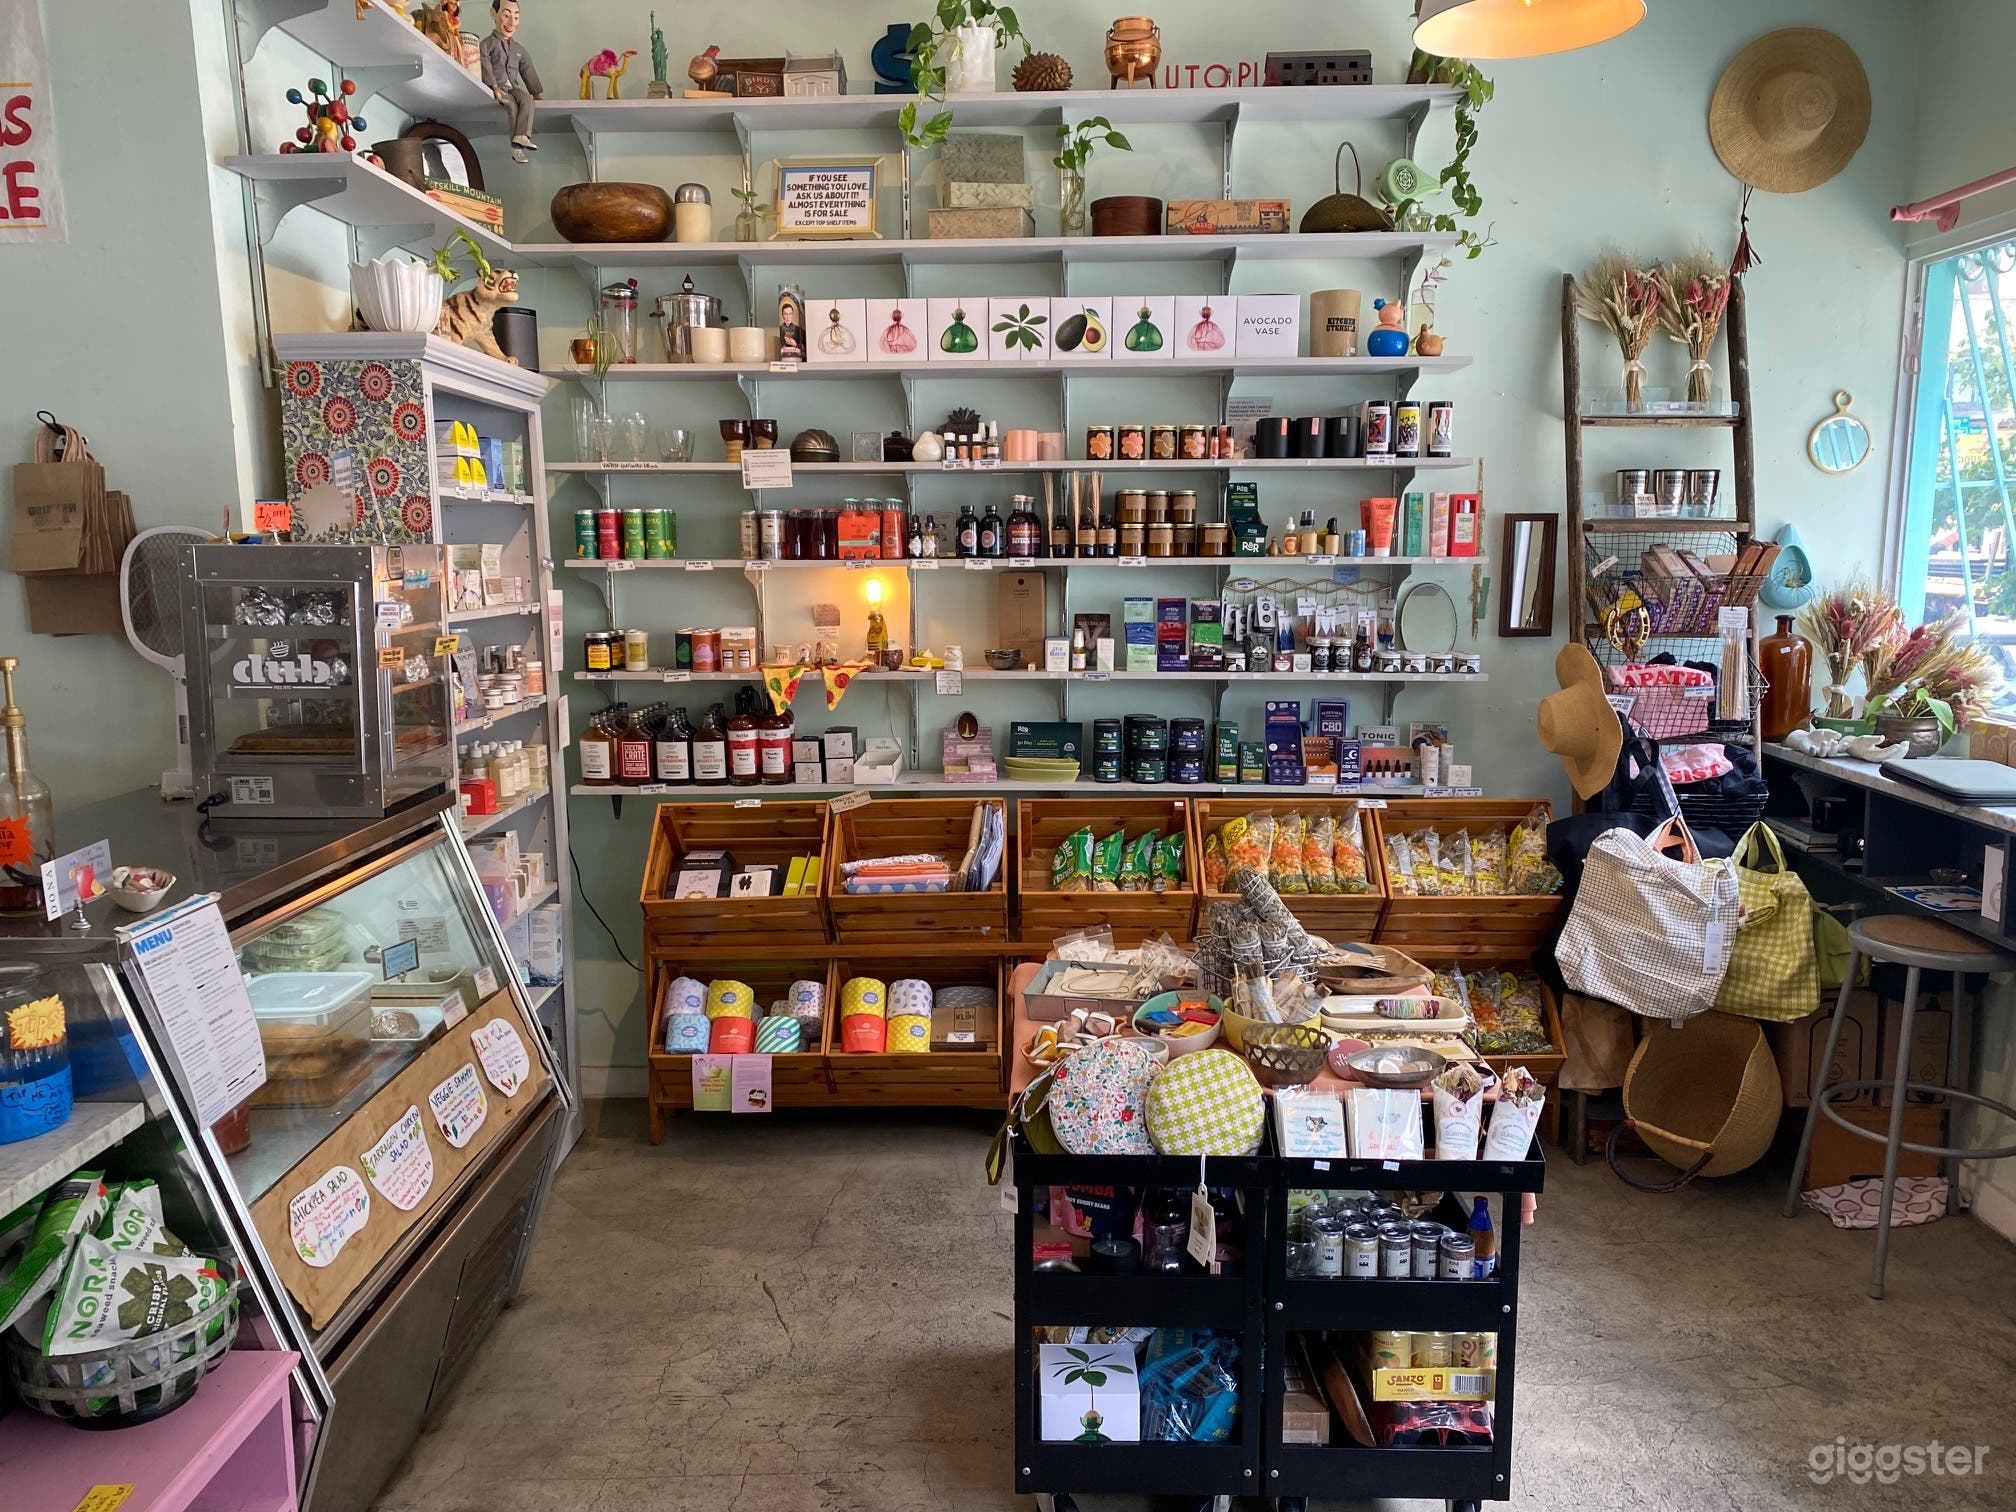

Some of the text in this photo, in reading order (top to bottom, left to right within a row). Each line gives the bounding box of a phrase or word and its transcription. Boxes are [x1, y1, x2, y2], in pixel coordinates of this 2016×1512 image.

[744, 76, 776, 87] BIRDS
[0, 95, 32, 147] S
[816, 174, 832, 182] YOU
[787, 183, 830, 191] SOMETHING
[831, 183, 846, 191] YOU
[463, 187, 502, 205] MOUNTAIN
[796, 192, 811, 200] ASK
[788, 200, 866, 209] ALMOST EVERYTHING
[829, 209, 848, 217] SALE
[1243, 317, 1293, 325] AVOCADO
[1327, 317, 1356, 326] KITCHEN
[233, 653, 331, 684] dub
[1321, 721, 1342, 733] CBD
[1361, 732, 1396, 740] TONIC
[624, 750, 646, 760] CRATE
[1669, 763, 1720, 784] SIST
[46, 869, 58, 914] DONA
[134, 928, 173, 955] MENU
[431, 1082, 454, 1108] VEGGIE
[369, 1130, 399, 1169] TARRAGON
[389, 1139, 409, 1163] SALAD
[326, 1171, 348, 1194] SALAD
[1387, 1375, 1425, 1386] SANZO
